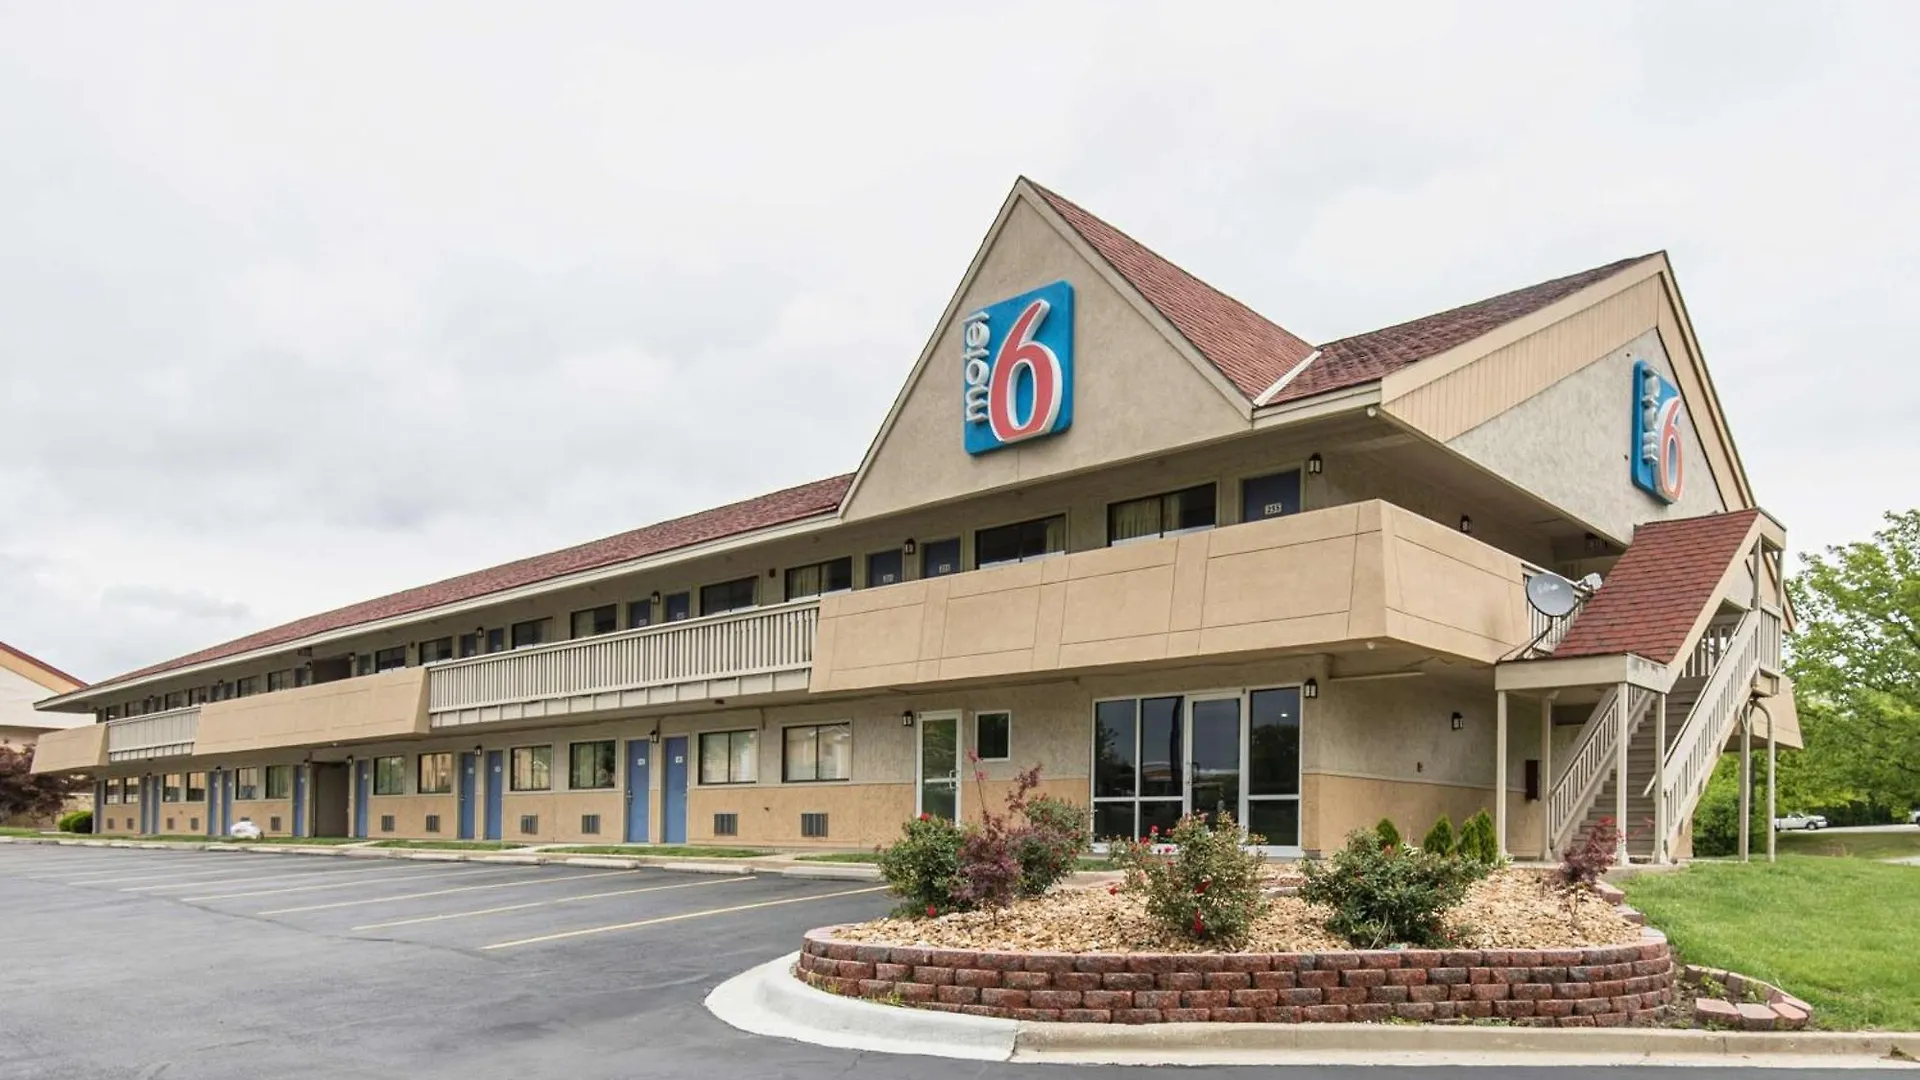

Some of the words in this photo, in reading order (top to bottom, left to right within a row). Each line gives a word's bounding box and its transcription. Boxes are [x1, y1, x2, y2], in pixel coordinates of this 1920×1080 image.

[963, 311, 990, 422] motel
[988, 299, 1063, 443] 6
[1656, 396, 1684, 502] 6
